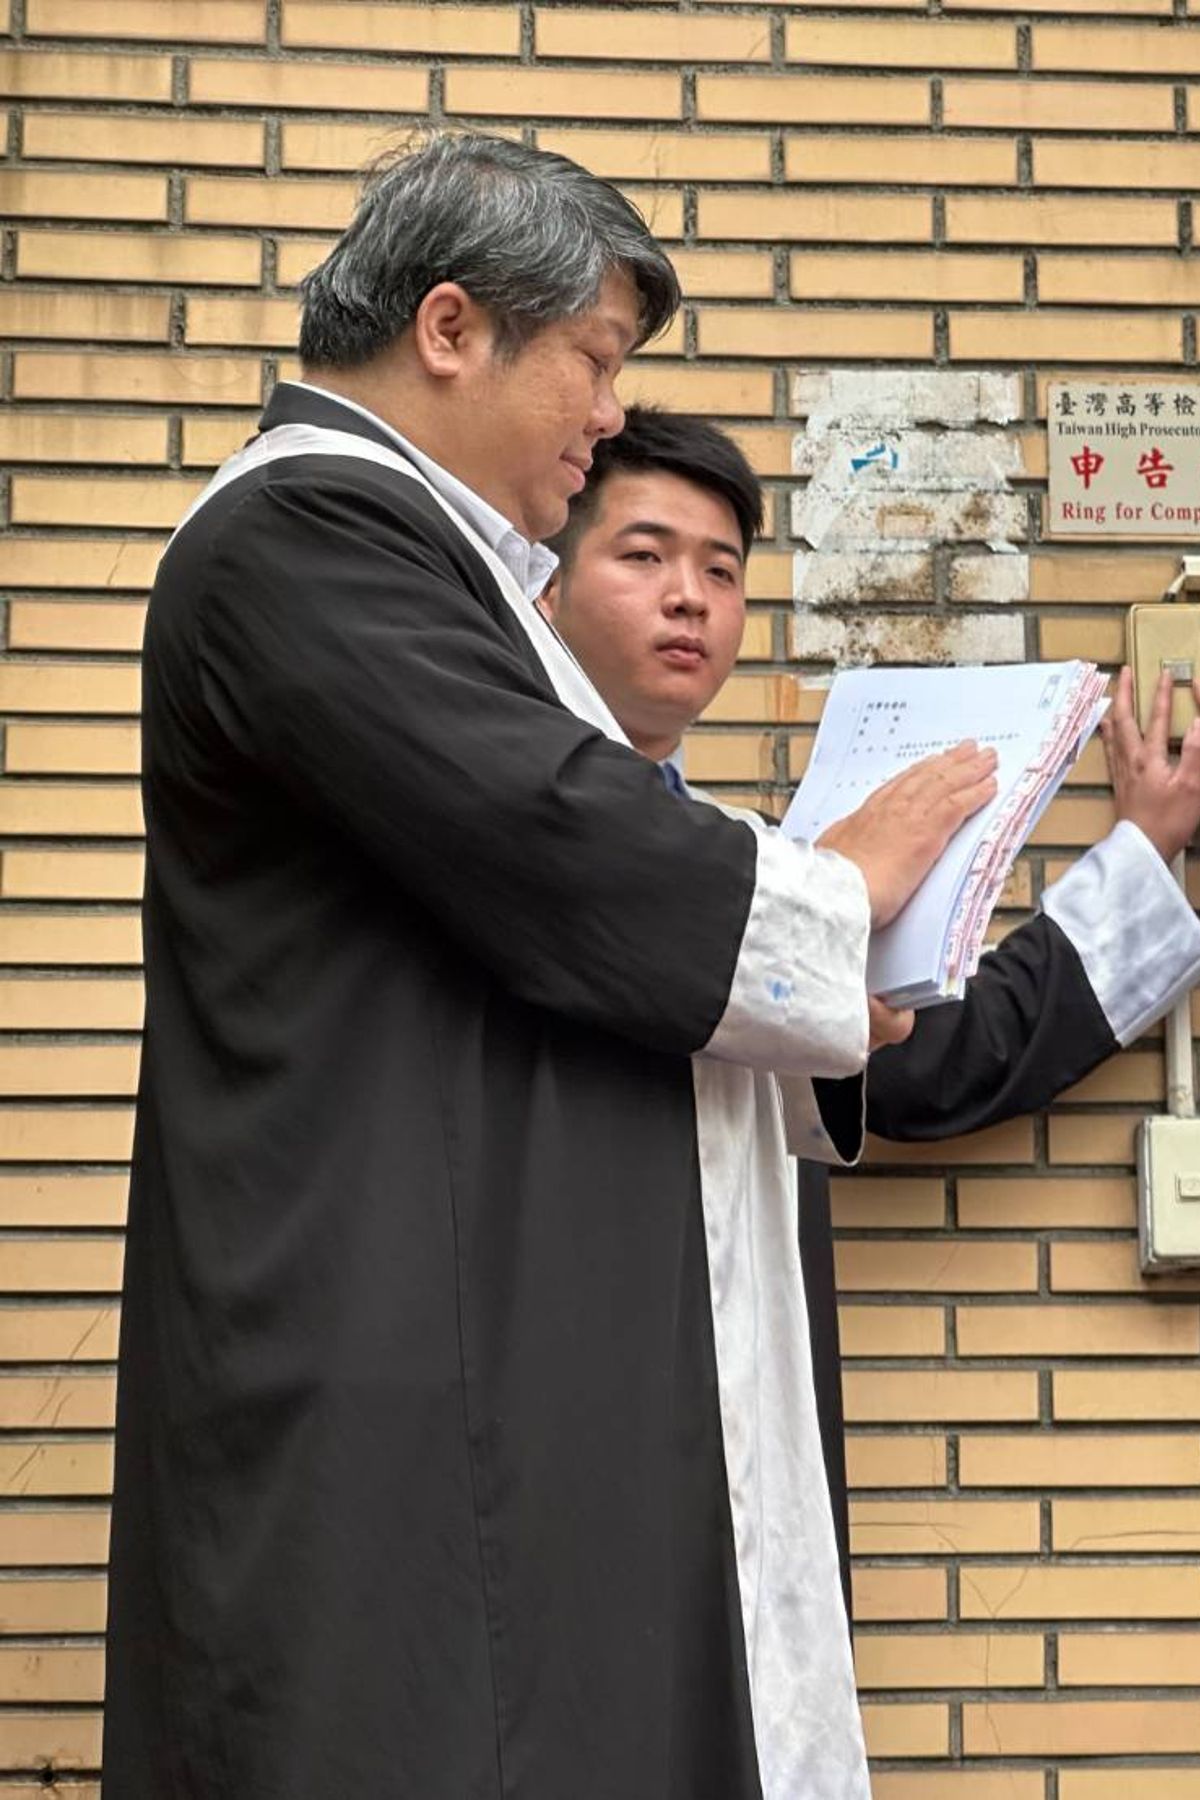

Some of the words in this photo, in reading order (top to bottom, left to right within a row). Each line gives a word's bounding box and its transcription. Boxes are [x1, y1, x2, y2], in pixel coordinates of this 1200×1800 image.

[1056, 422, 1103, 436] Taiwan
[1105, 423, 1137, 438] High
[1062, 502, 1106, 523] Ring
[1115, 502, 1143, 520] for
